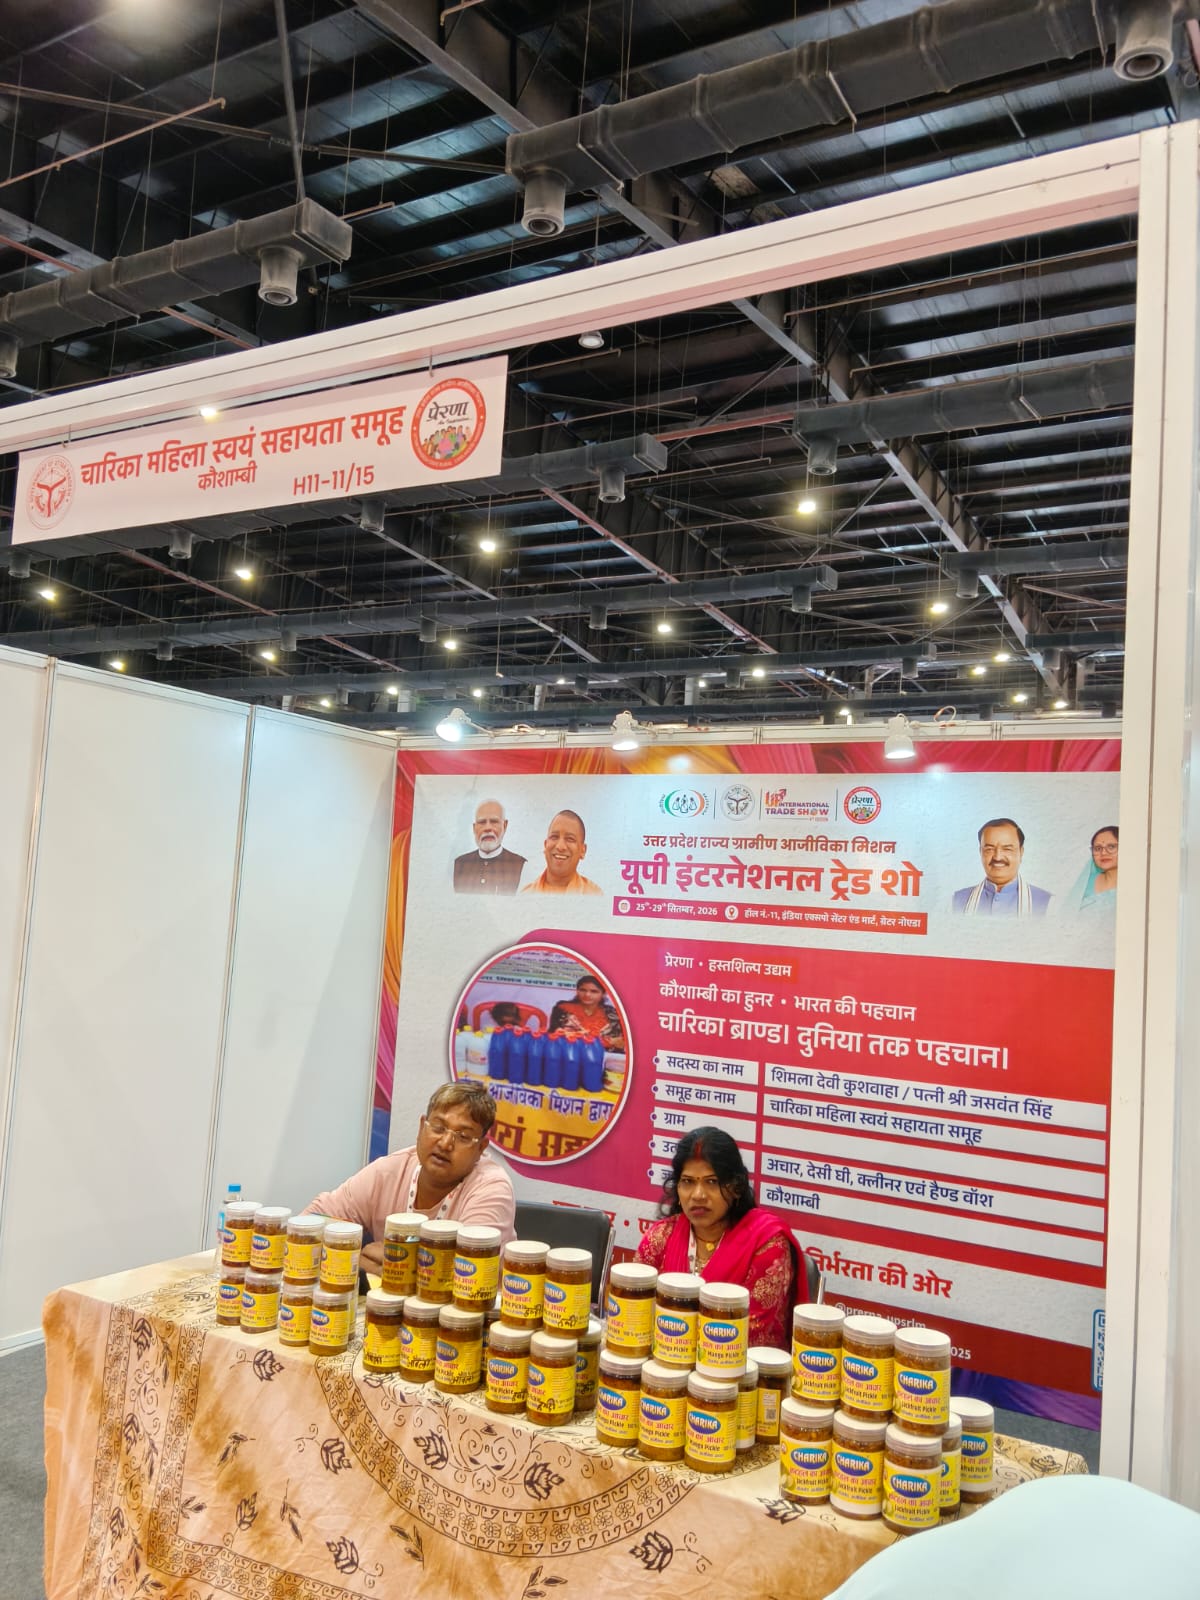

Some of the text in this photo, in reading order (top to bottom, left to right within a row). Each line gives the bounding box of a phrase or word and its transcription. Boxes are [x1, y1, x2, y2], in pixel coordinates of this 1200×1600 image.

[81, 405, 407, 485] चारिका महिला स्वयं सहायता समूह
[198, 460, 257, 490] कौशाम्बी
[293, 462, 375, 496] H11-11/15
[643, 833, 897, 854] उत्तर प्रदेश राज्य ग्रामीण आजीविका मिशन
[620, 853, 923, 901] यूपी इंटरनेशनल ट्रेड शो
[698, 906, 718, 916] 2026
[665, 952, 792, 977] प्रेरणा हस्तशिल्प उद्यम
[659, 979, 917, 1021] कौशाम्बी का हुनर भारत की पहचान
[658, 1008, 725, 1037] चारिका
[797, 1022, 863, 1058] दुनिया
[867, 1034, 911, 1057] तक
[666, 1056, 744, 1076] सदस्य का नाम
[665, 1084, 736, 1105] समूह का नाम
[771, 1067, 1053, 1120] शिमला देवी कुशवाहा / पत्नी श्री जसवंत सिंह
[664, 1112, 686, 1127] ग्राम
[770, 1098, 983, 1145] चारिका महिला स्वयं सहायता समूह
[767, 1158, 803, 1177] अचार,
[807, 1161, 832, 1180] देसी
[857, 1172, 902, 1192] क्लीनर
[905, 1180, 926, 1196] एवं
[929, 1181, 958, 1202] हैण्ड
[962, 1188, 994, 1208] वॉश
[766, 1187, 820, 1210] कौशाम्बी
[877, 1262, 908, 1288] की
[912, 1269, 953, 1298] ओर
[657, 1317, 686, 1331] CHARIKA
[704, 1324, 736, 1337] CHARIKA
[801, 1353, 834, 1367] CHARIKA
[844, 1359, 874, 1376] CHARIKA
[899, 1374, 934, 1390] CHARIKA
[689, 1412, 718, 1429] CHARIKA
[793, 1451, 827, 1464] CHARIKA
[836, 1454, 870, 1471] CHARIKA
[892, 1476, 928, 1492] CHARIKA
